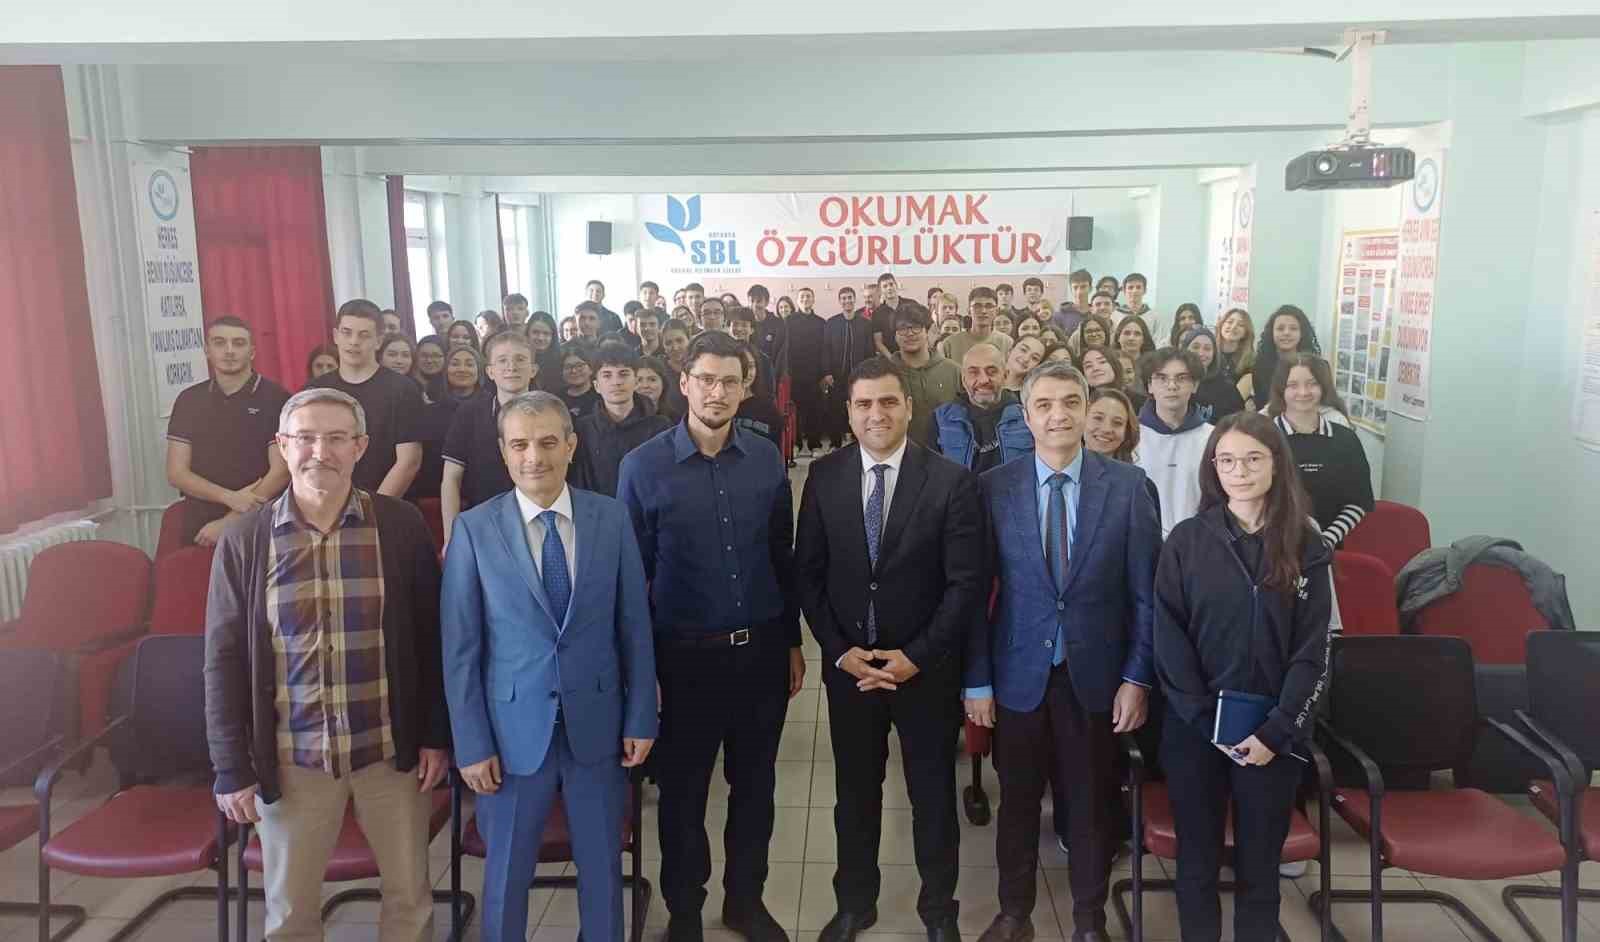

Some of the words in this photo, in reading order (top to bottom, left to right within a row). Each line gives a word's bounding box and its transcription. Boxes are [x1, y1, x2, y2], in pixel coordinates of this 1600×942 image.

[819, 193, 989, 228] OKUMAK
[690, 239, 741, 265] SBL
[755, 225, 1053, 267] ÖZGÜRLÜKTÜR.
